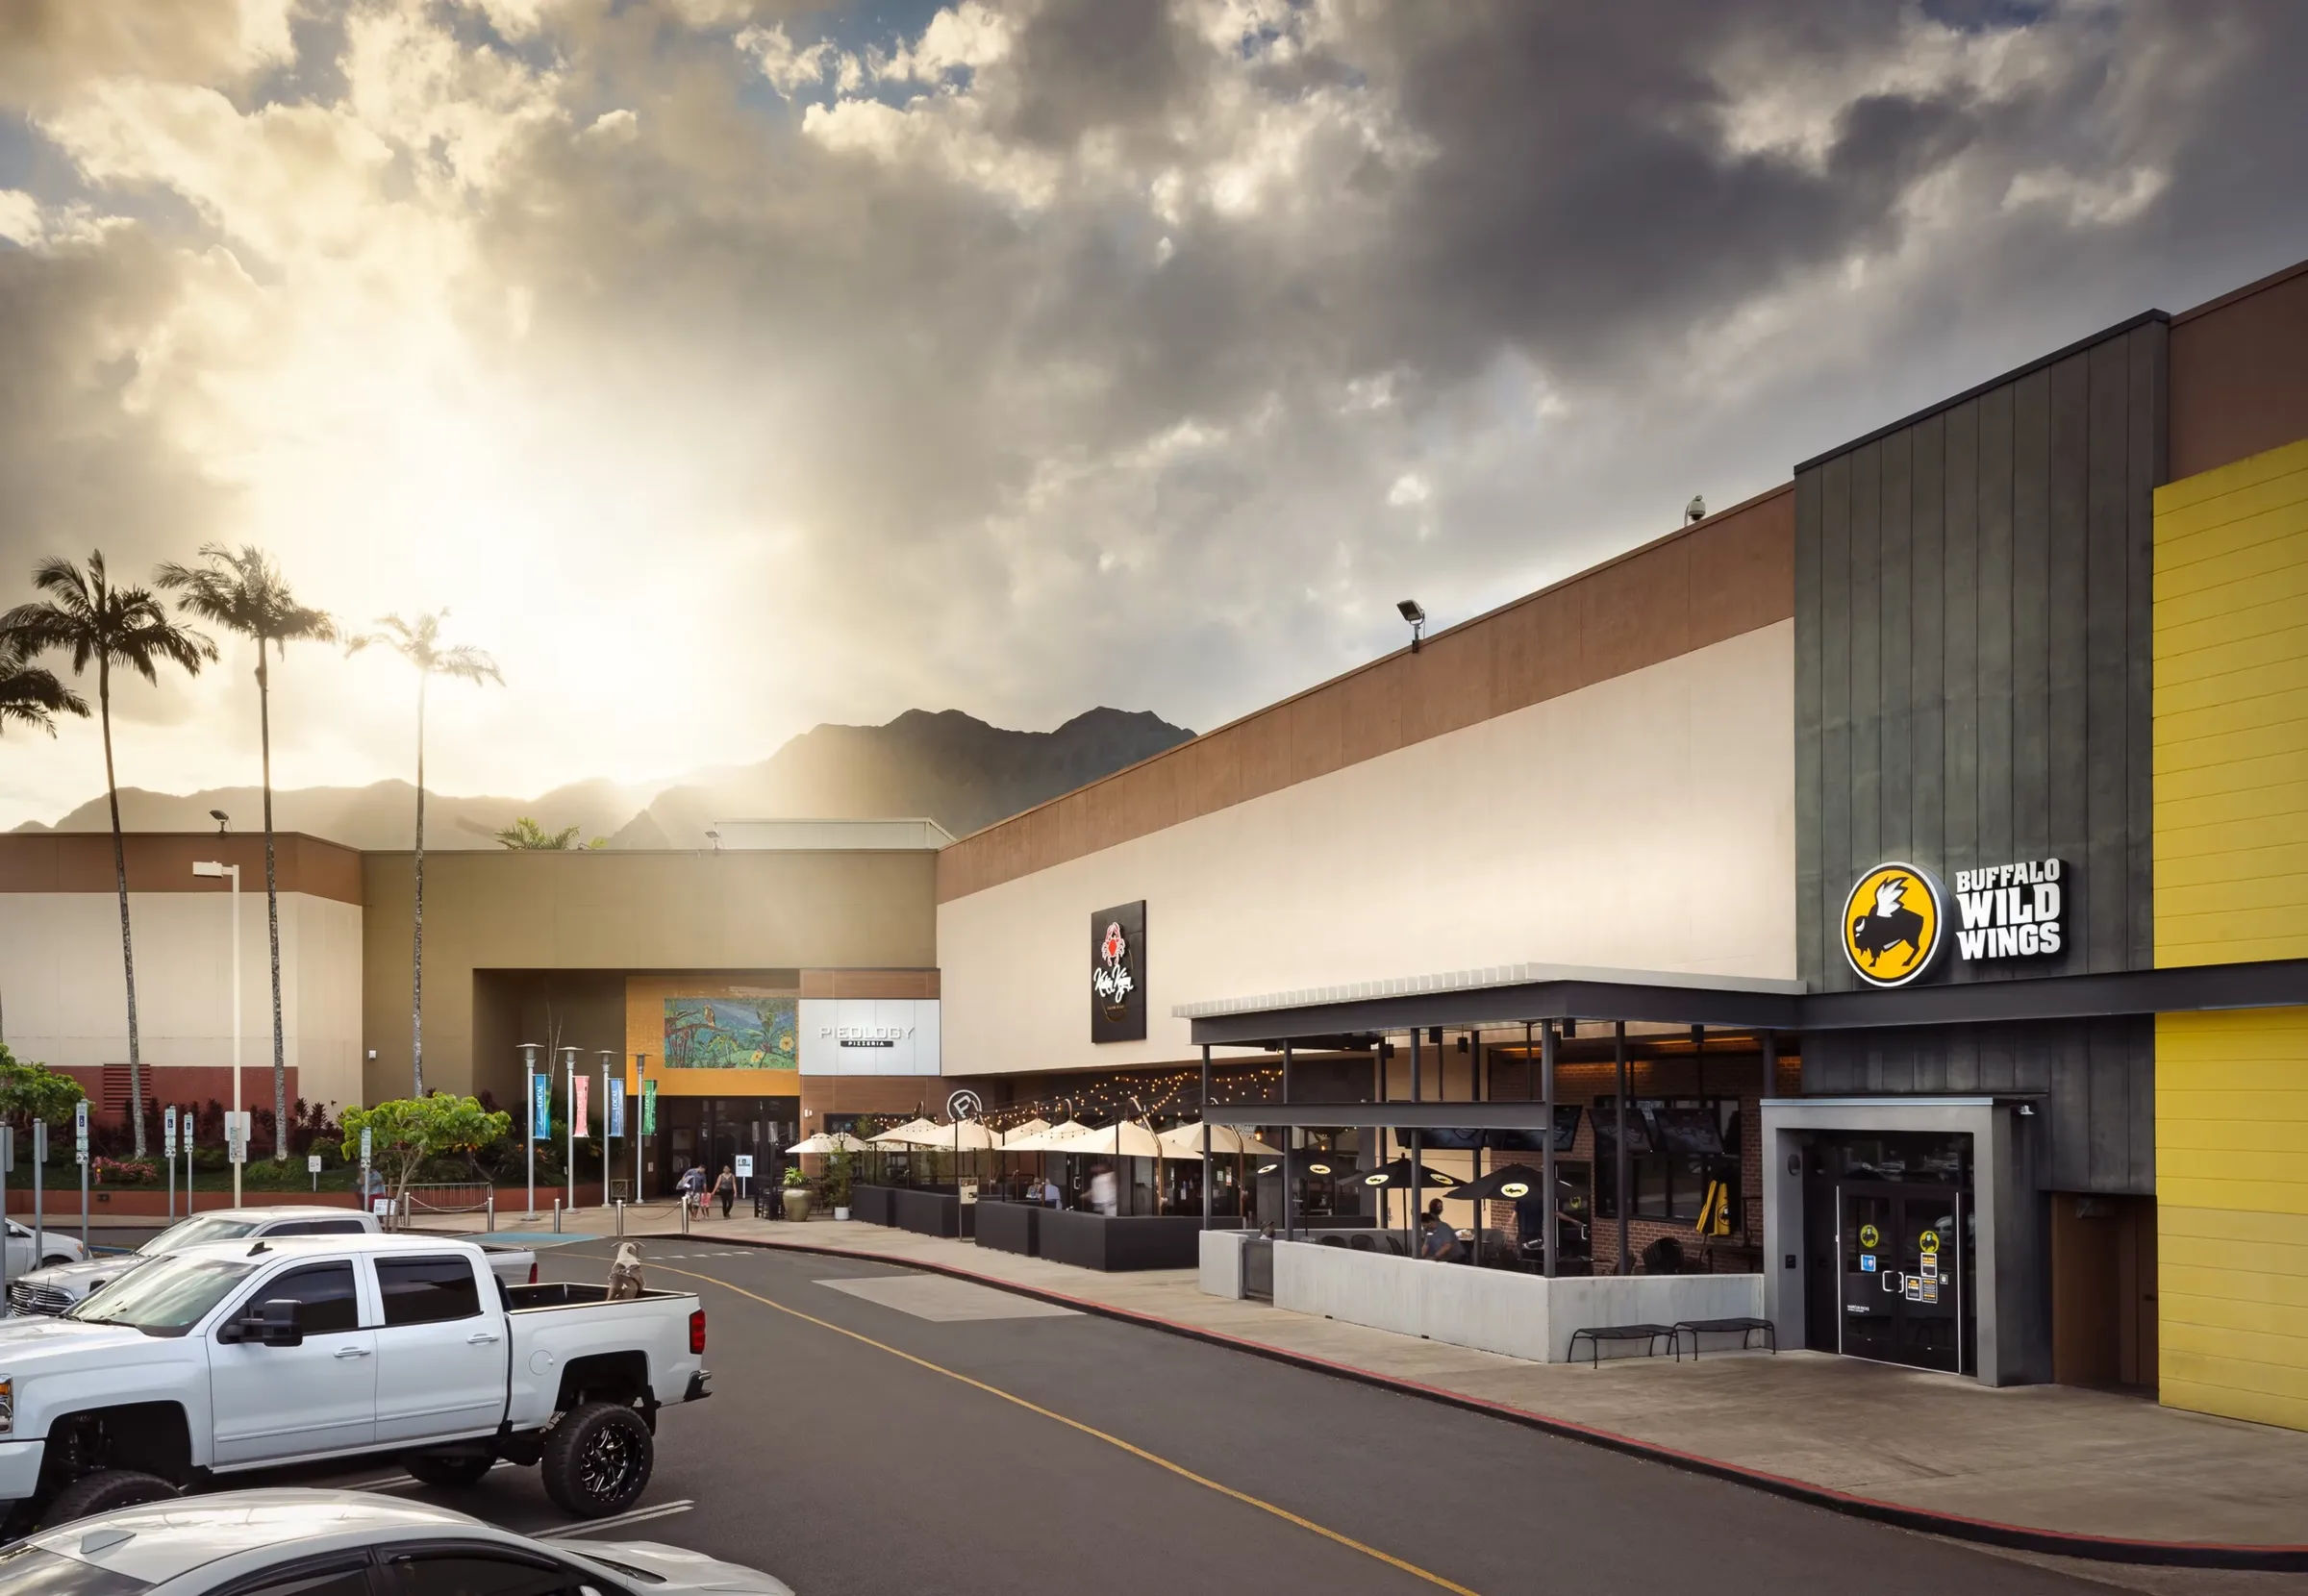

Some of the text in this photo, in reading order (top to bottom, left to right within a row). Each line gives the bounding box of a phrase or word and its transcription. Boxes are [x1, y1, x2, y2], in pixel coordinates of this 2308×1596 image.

[1955, 858, 2060, 893] BUFFALO
[1955, 882, 2061, 930] WILD
[1955, 921, 2061, 960] WINGS
[819, 1026, 916, 1039] PIEOLOGY
